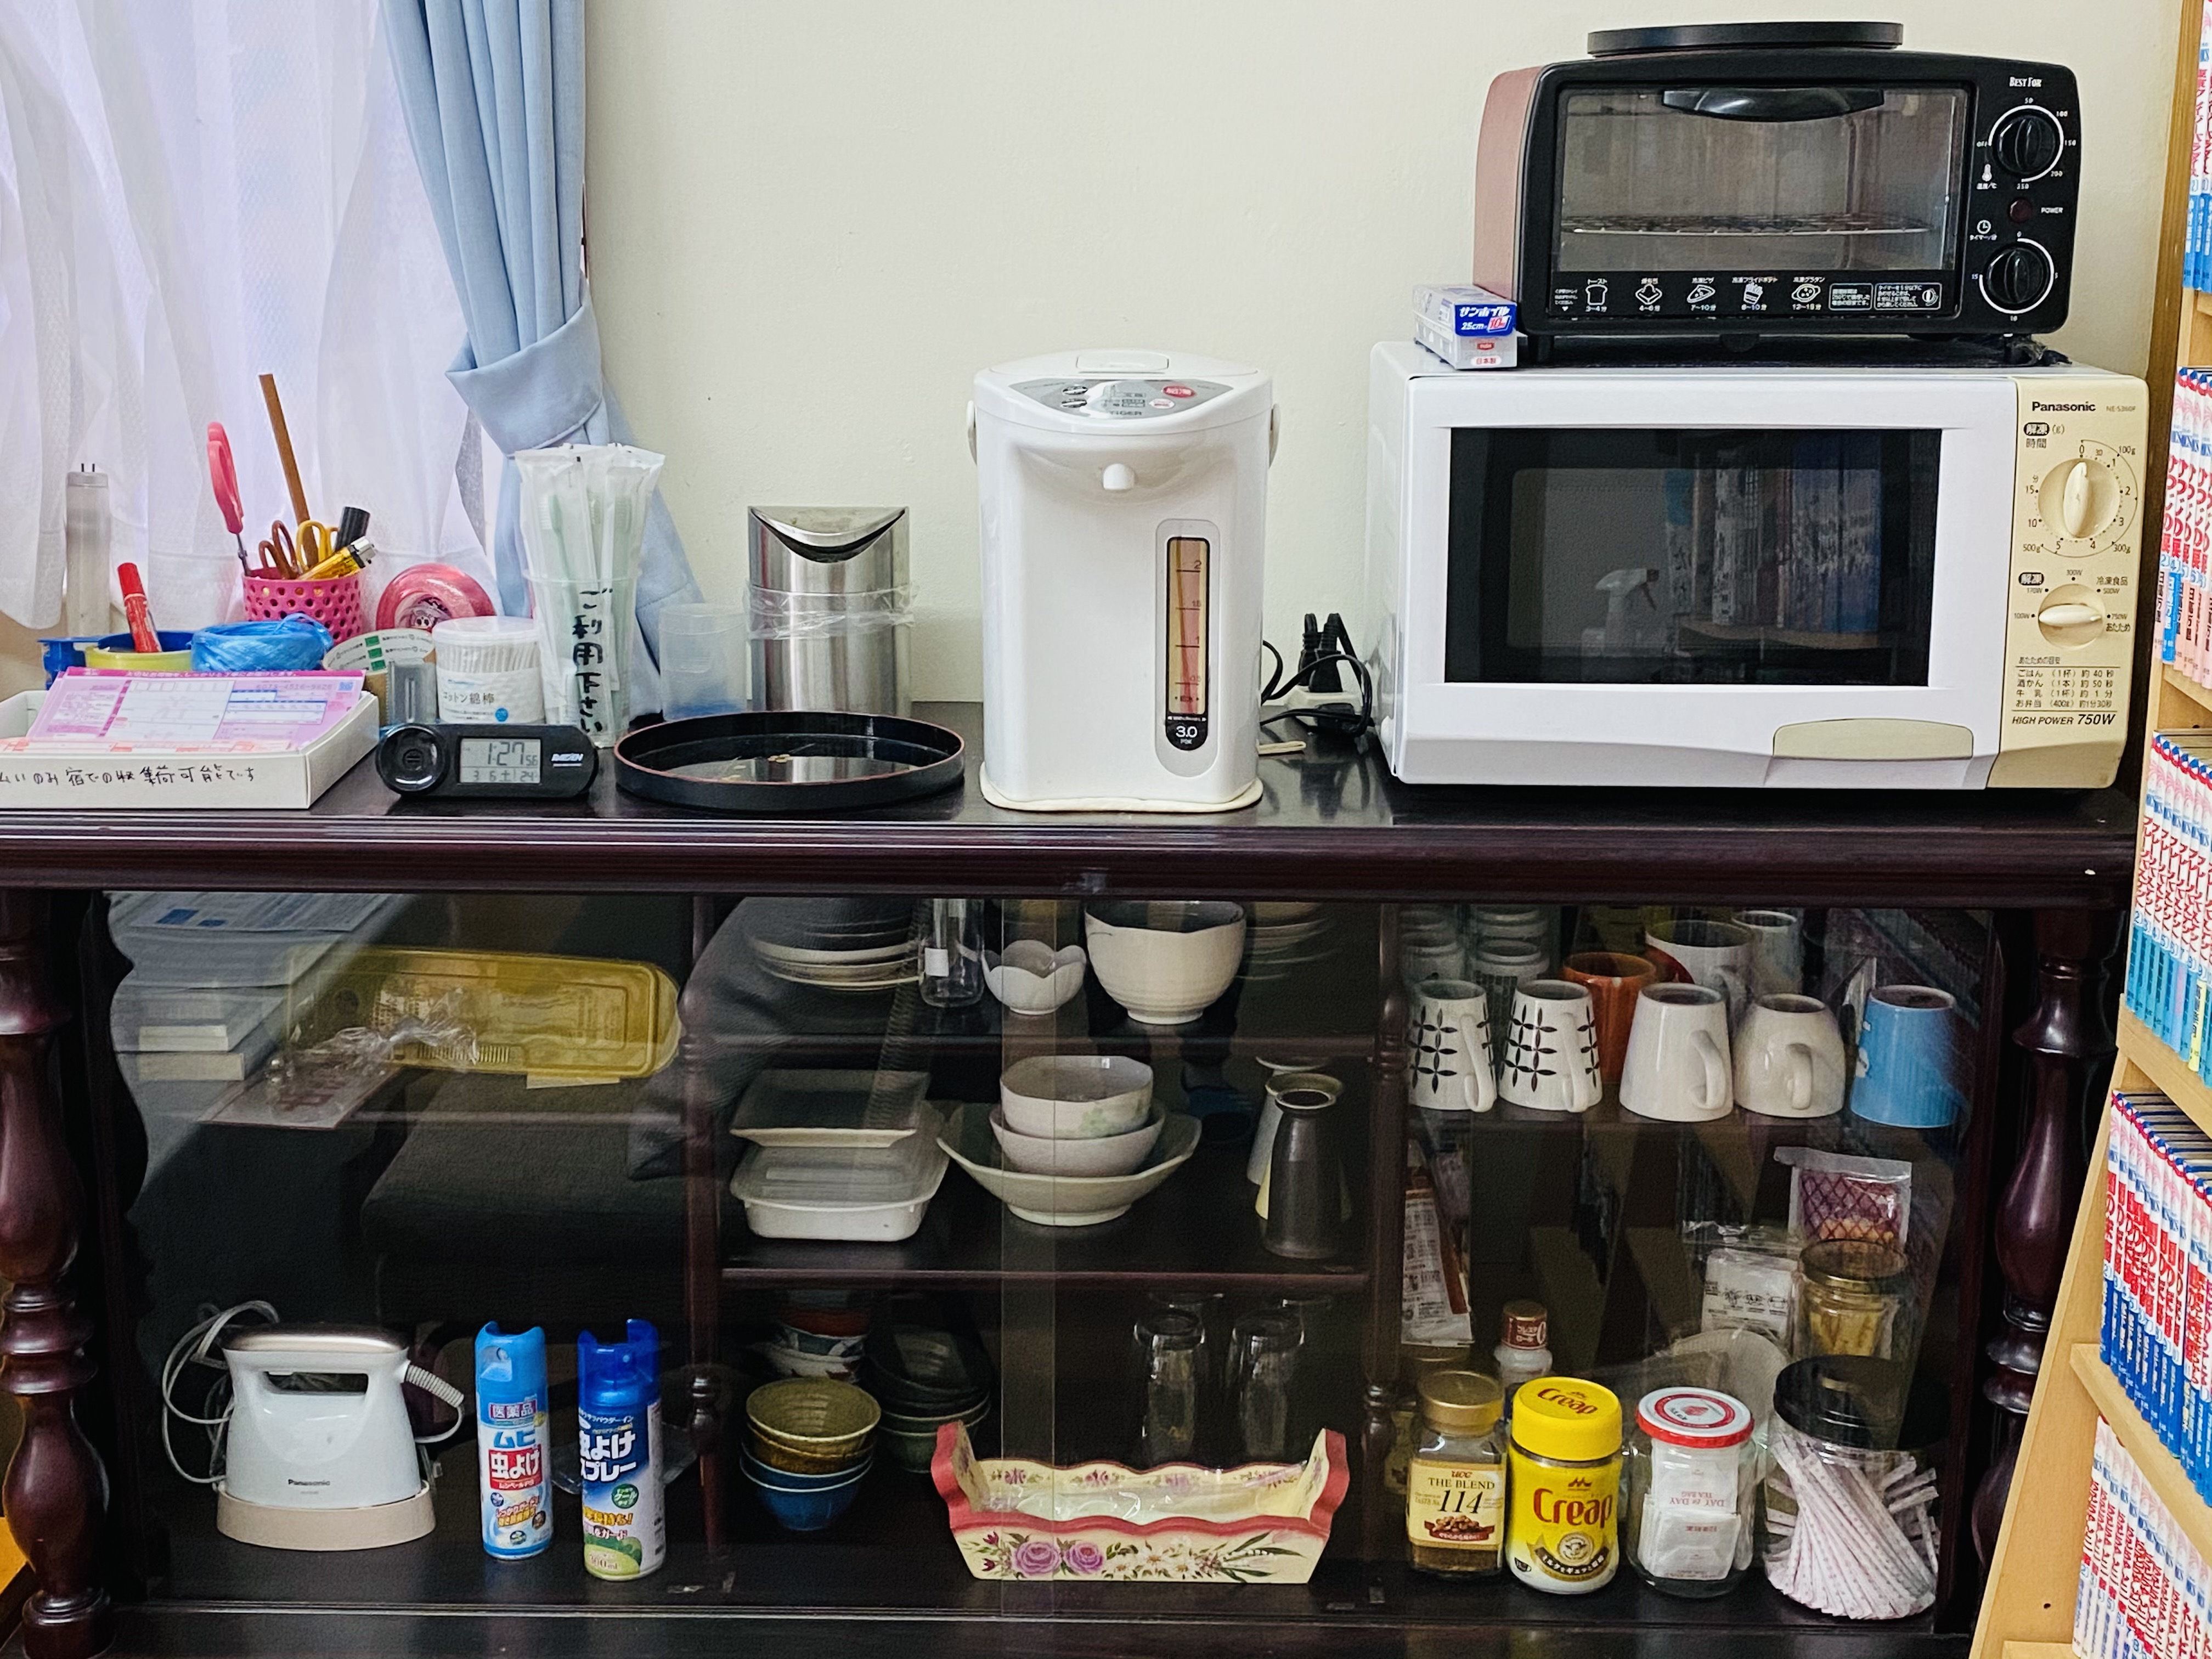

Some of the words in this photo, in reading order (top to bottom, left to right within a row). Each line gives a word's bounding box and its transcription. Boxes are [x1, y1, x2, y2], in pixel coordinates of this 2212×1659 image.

[1459, 306, 1510, 317] サンホイル
[2032, 401, 2096, 412] Panasonic
[2025, 438, 2047, 449] 時間
[2079, 445, 2085, 455] 0
[2118, 445, 2136, 456] 100g
[2025, 486, 2035, 494] 15
[2125, 486, 2131, 496] 2
[2028, 518, 2038, 527] 10
[2119, 517, 2125, 527] 3
[2023, 543, 2041, 554] 500g
[2056, 541, 2062, 550] 5
[2090, 541, 2096, 550] 4
[2113, 544, 2131, 554] 300g
[1193, 560, 1202, 569] 2
[2096, 576, 2128, 586] 冷凍食品
[2106, 623, 2131, 632] あたため
[1195, 636, 1200, 644] 1
[2017, 669, 2044, 678] ごはん
[2016, 699, 2042, 708] お弁当
[2077, 714, 2116, 725] 750W
[1175, 725, 1198, 738] 3.0
[1537, 1387, 1598, 1415] Creap
[492, 1402, 534, 1419] 医薬品
[493, 1428, 537, 1449] ムヒ
[490, 1448, 541, 1480] 虫よけ
[1427, 1477, 1453, 1488] THE
[1455, 1480, 1496, 1490] BLEND
[1437, 1489, 1483, 1514] 114
[1533, 1488, 1613, 1530] Creap
